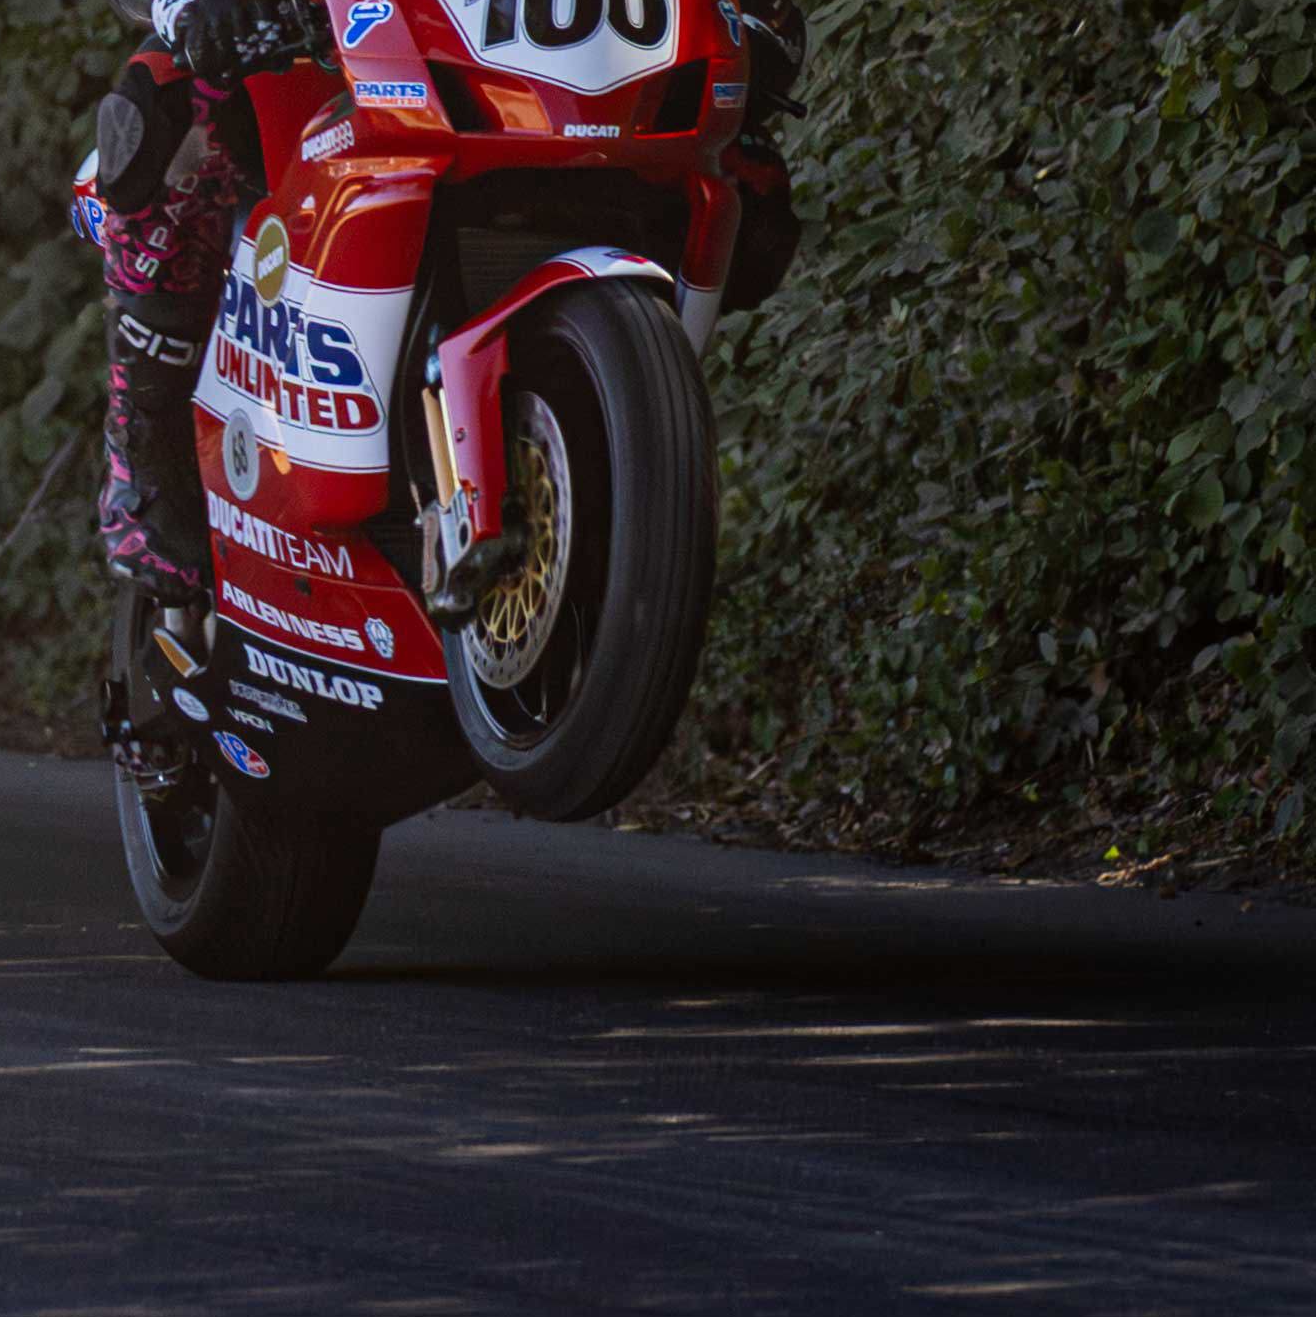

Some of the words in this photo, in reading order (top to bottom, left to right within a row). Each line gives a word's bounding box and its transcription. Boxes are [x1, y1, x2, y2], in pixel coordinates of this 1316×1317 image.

[355, 83, 426, 97] PARTS
[564, 124, 620, 138] DUCATI
[219, 274, 363, 387] PARTS
[244, 643, 384, 711] DUNLOP
